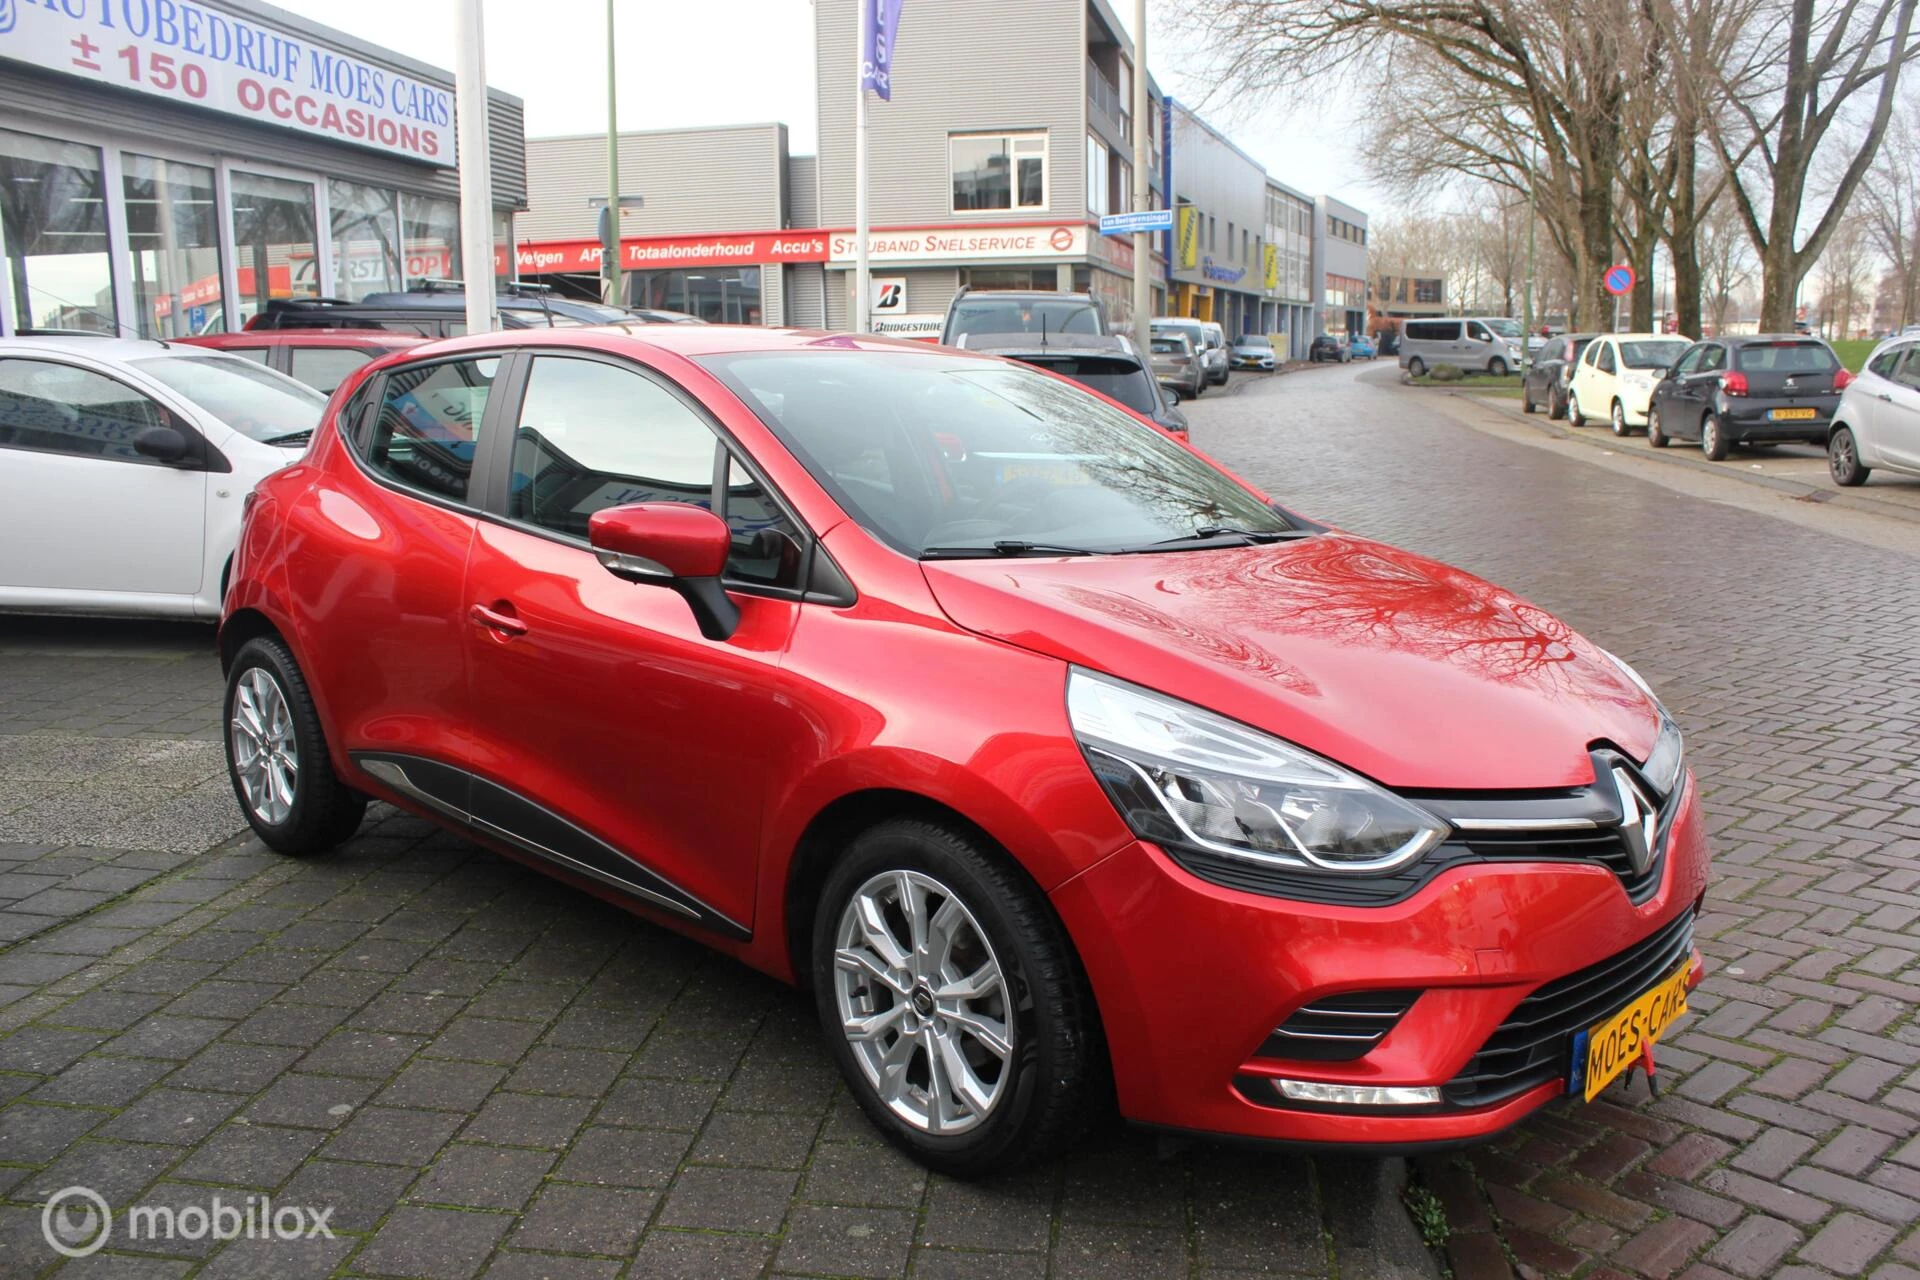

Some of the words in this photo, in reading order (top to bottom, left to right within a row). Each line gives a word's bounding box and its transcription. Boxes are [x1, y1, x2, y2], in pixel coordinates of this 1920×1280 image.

[24, 0, 301, 83] TOBEDRIJF
[310, 50, 385, 109] MOES
[391, 78, 449, 128] CARS
[118, 45, 208, 99] 150
[236, 78, 439, 156] OCCASIONS
[516, 251, 563, 268] Velgen
[629, 241, 755, 260] Totaalonderhoud
[770, 239, 824, 255] Accu's
[833, 238, 920, 255] STUBAND
[924, 235, 1036, 251] SNELSERVICE
[874, 321, 943, 333] BRIDGESTONE
[1587, 967, 1692, 1092] MOES-CARS
